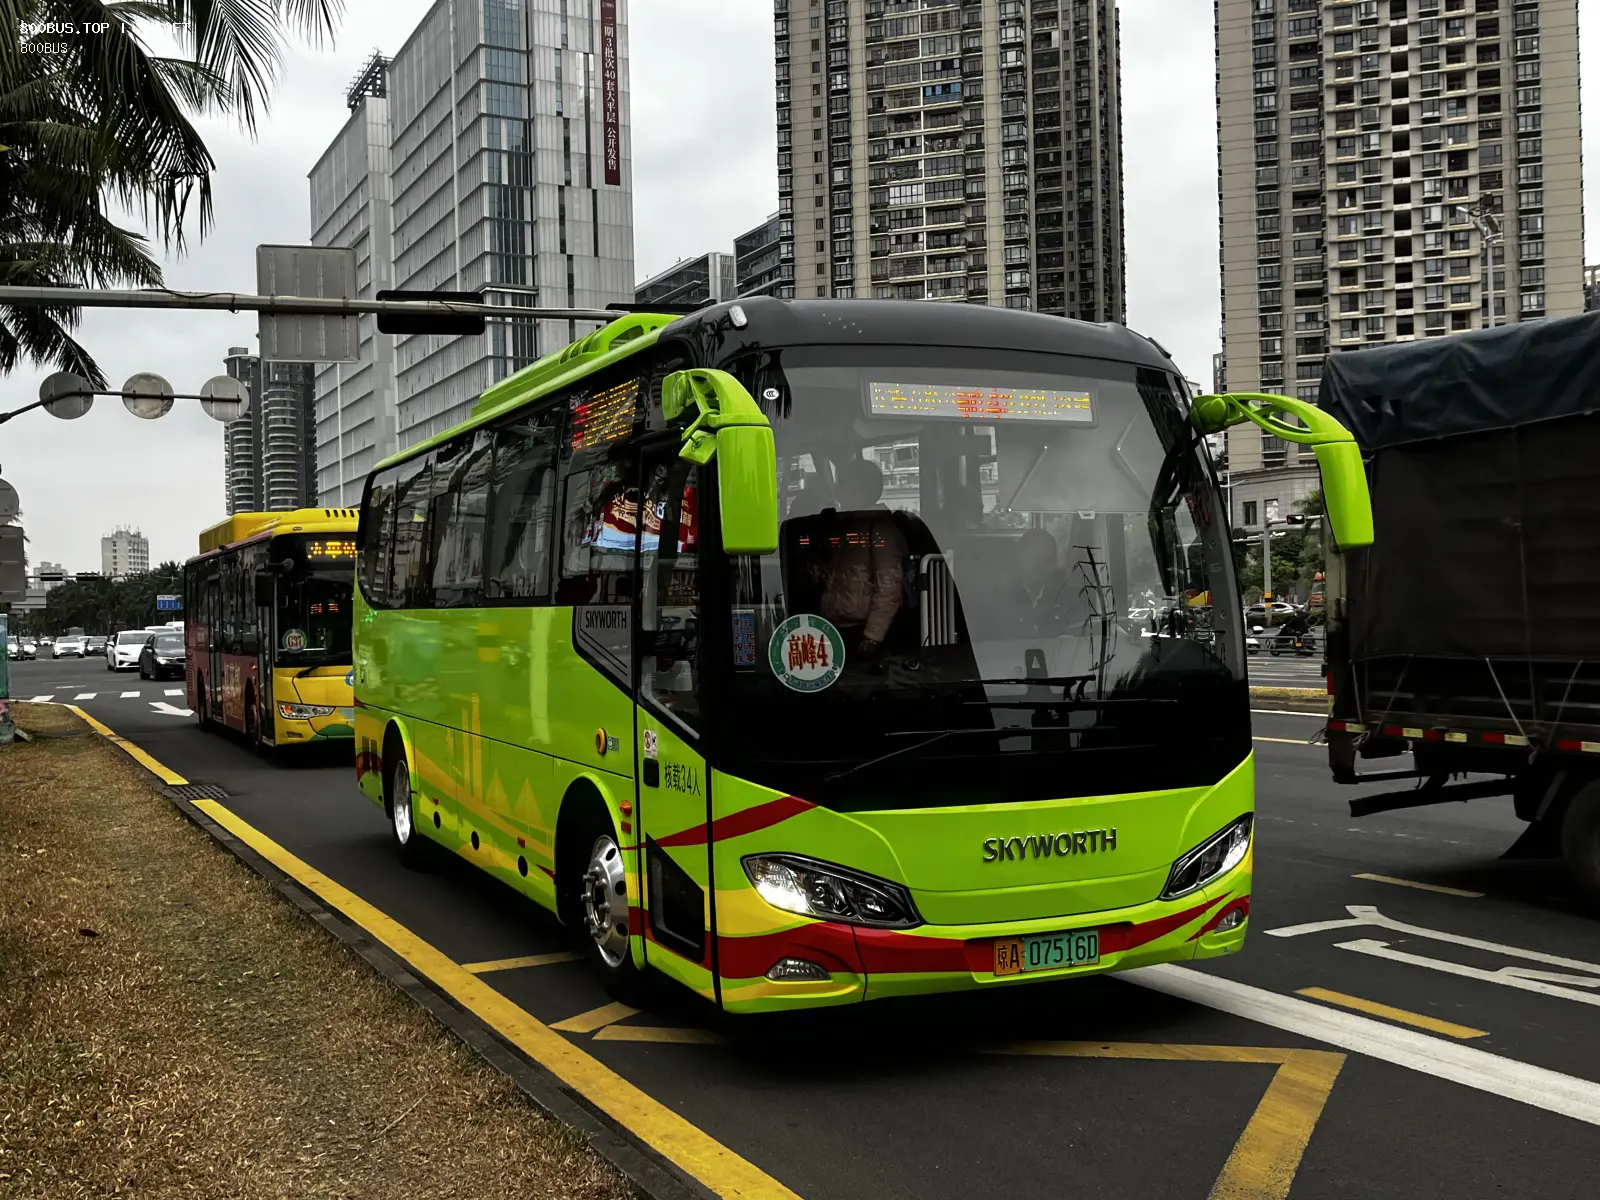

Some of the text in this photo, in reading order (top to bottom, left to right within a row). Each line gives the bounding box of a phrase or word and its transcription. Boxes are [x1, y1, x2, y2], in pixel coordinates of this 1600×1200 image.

[606, 127, 617, 171] 公开发售
[585, 610, 627, 629] SKYWORTH
[787, 633, 829, 671] 高峰4
[664, 761, 701, 796] 核载34人
[983, 828, 1117, 863] SKYWORTH
